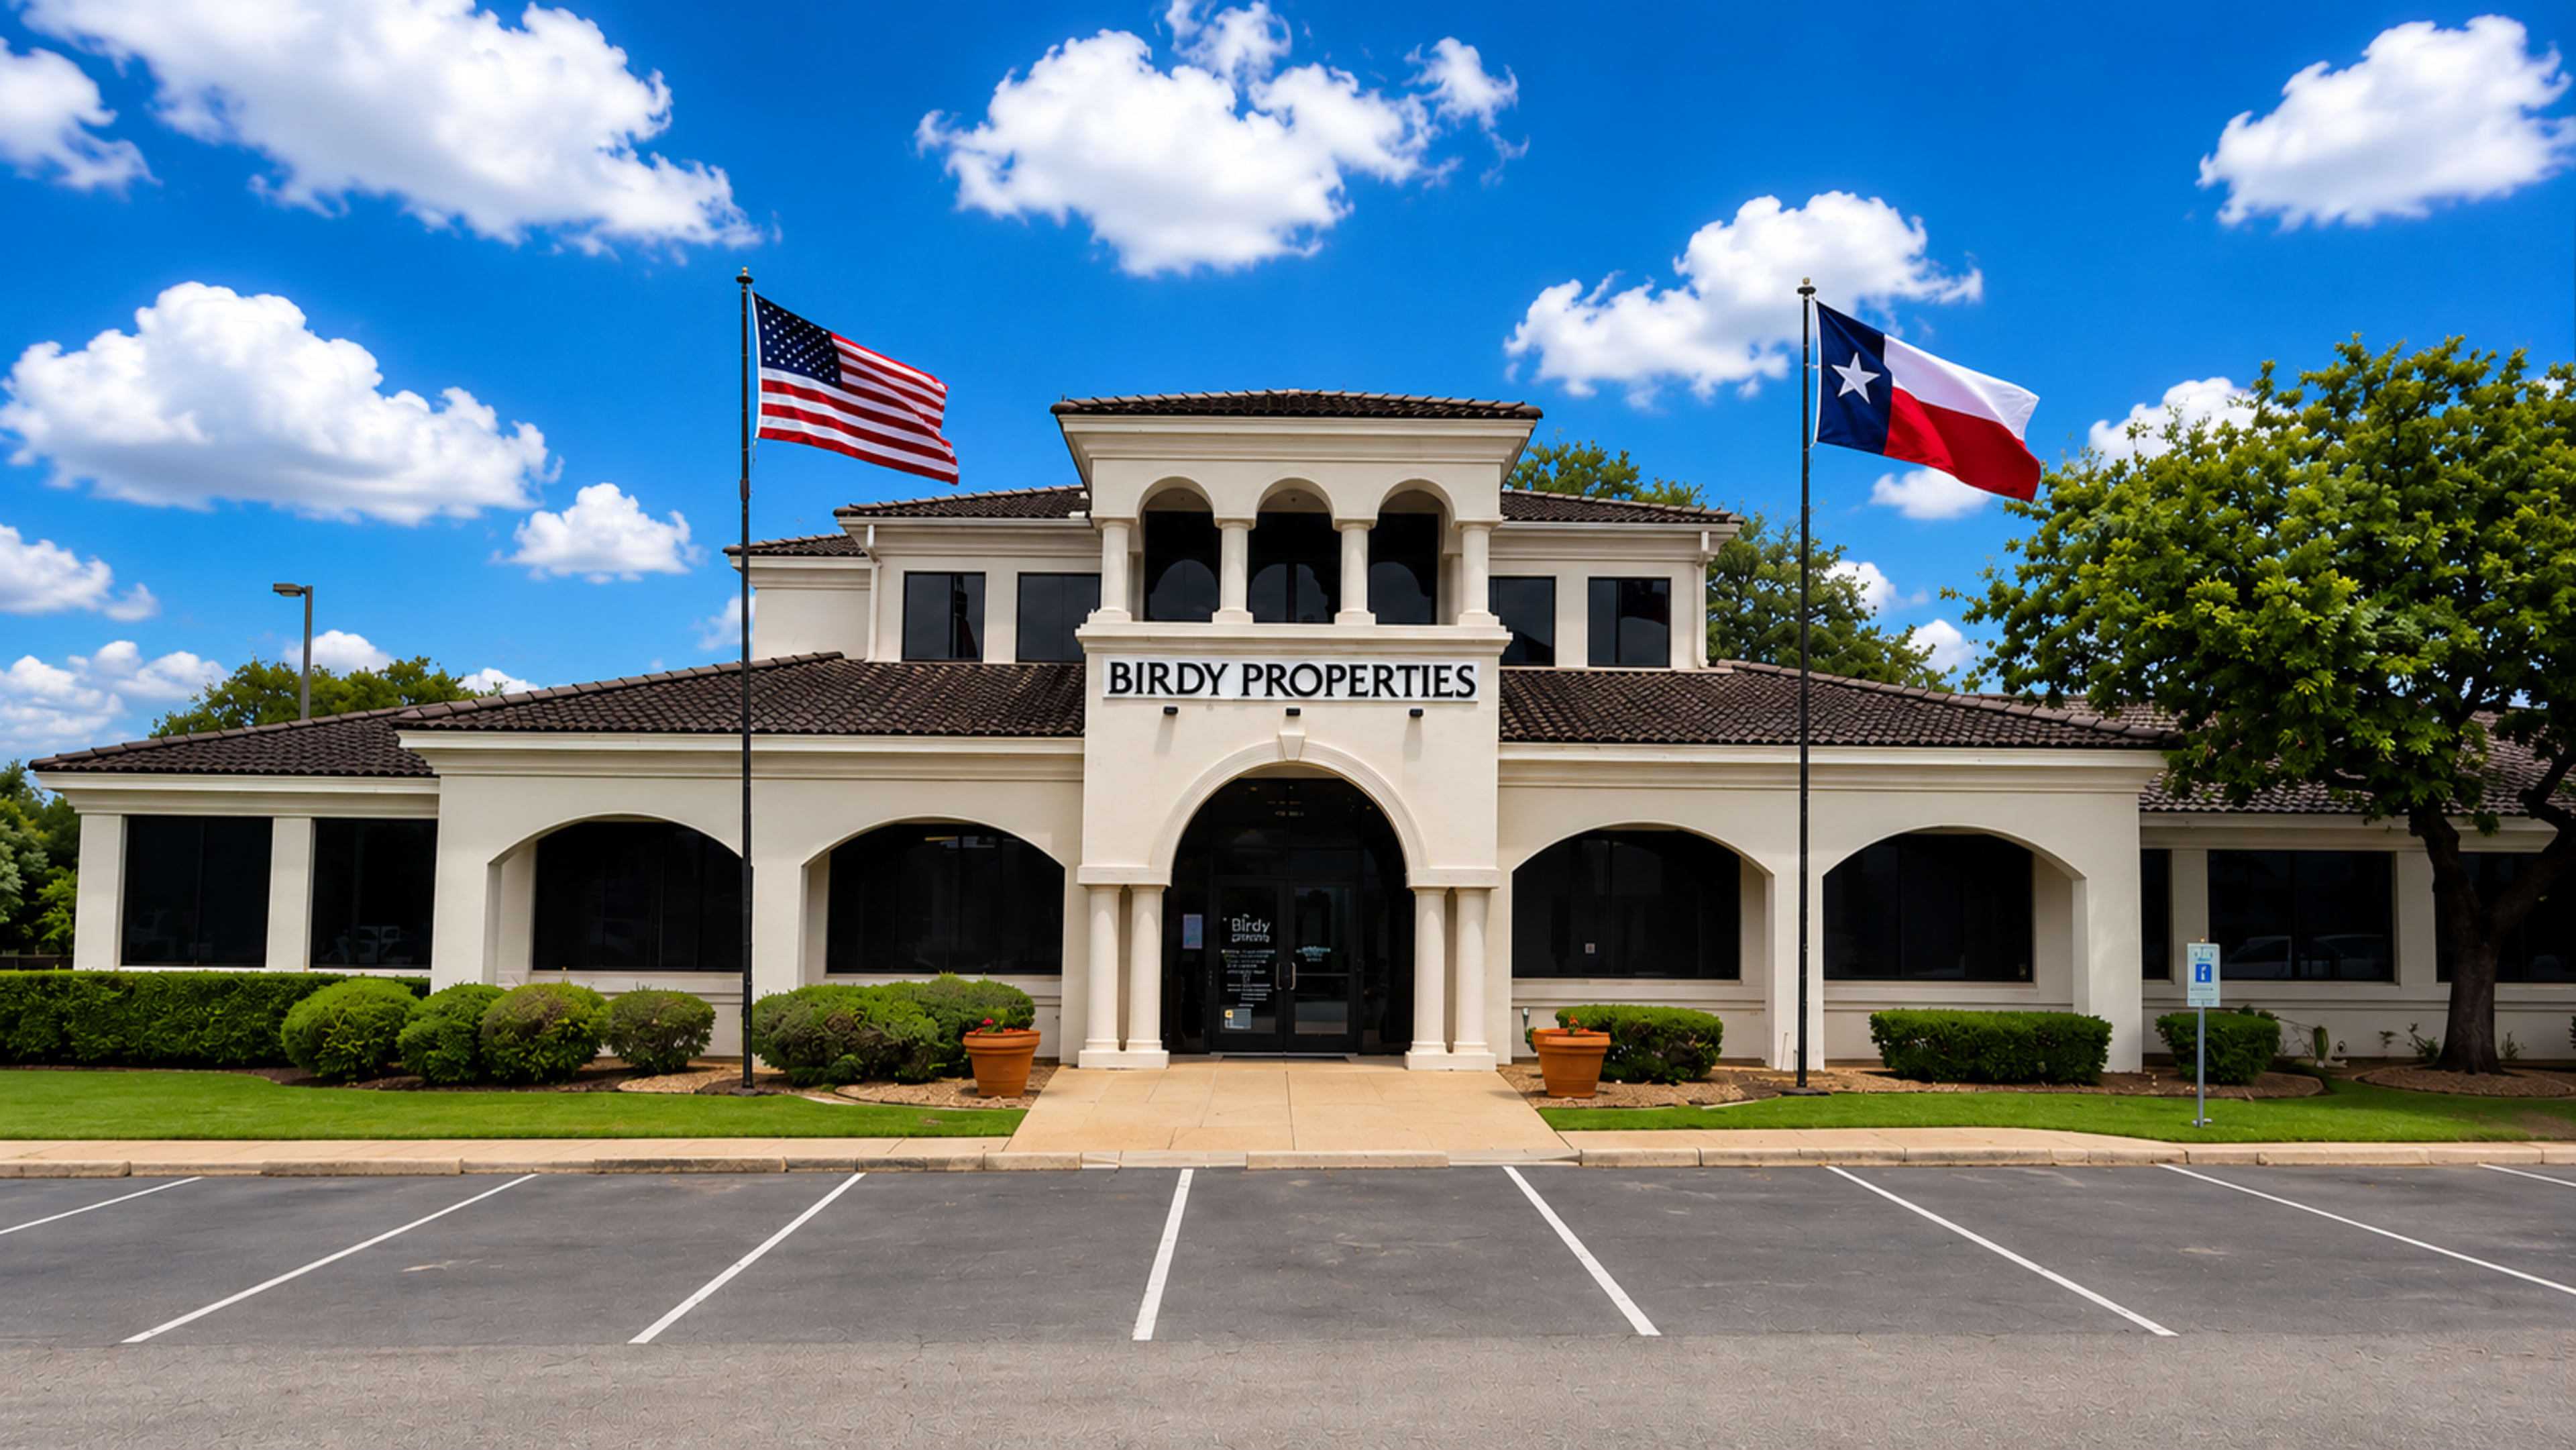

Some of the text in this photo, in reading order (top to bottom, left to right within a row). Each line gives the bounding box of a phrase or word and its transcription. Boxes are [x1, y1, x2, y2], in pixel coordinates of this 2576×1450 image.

[1109, 662, 1475, 698] BIRDY PROPERTIES
[1232, 917, 1269, 933] Birdy
